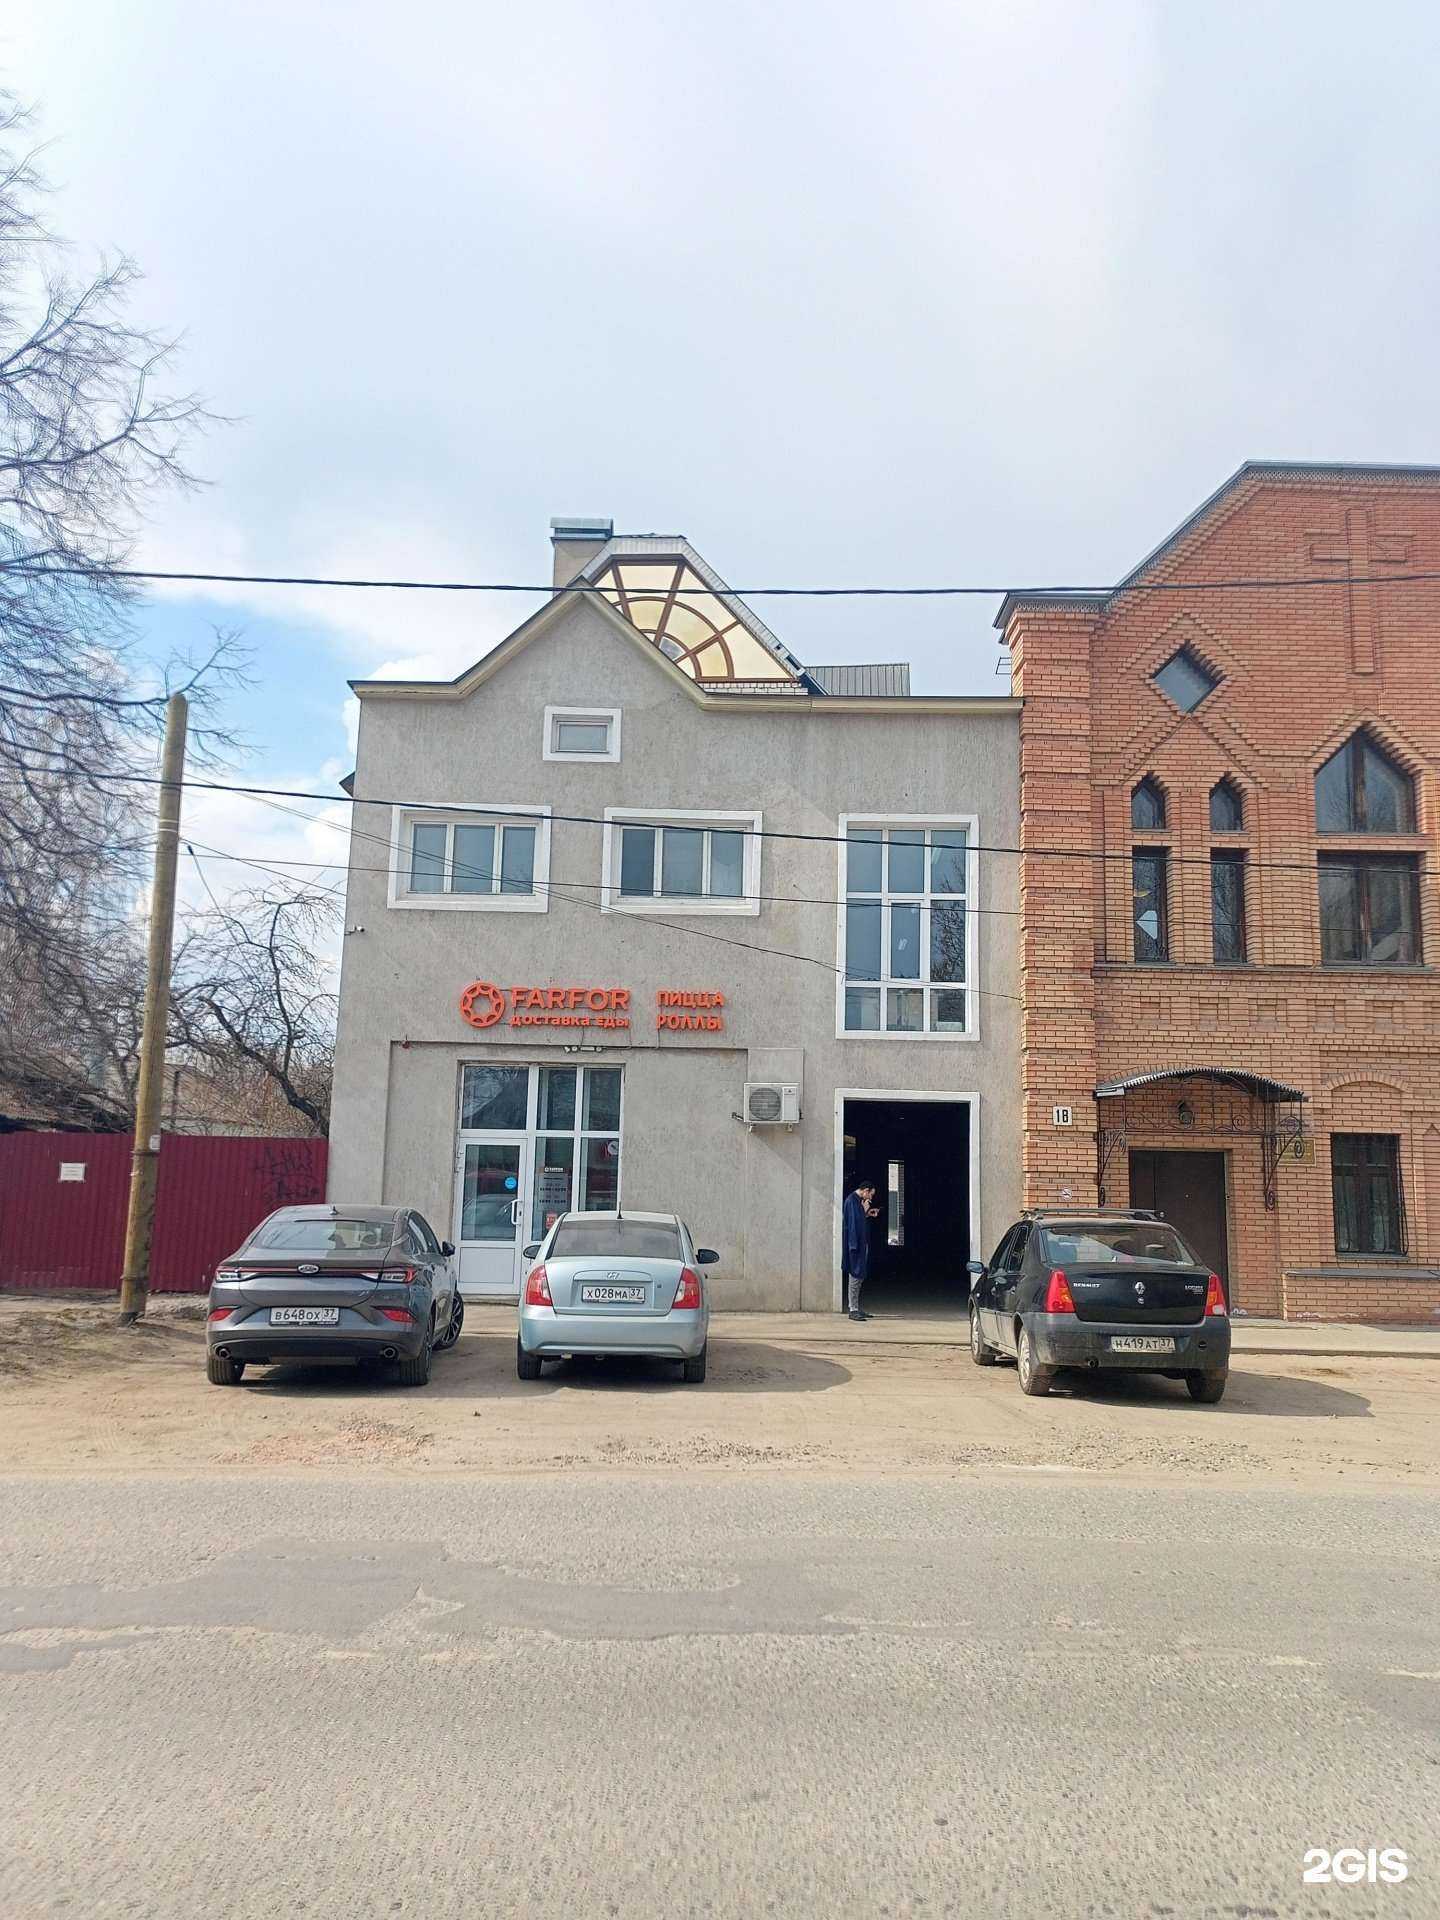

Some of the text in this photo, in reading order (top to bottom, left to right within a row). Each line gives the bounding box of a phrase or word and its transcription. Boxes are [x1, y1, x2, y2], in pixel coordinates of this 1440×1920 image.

[511, 986, 630, 1010] FARFOR
[656, 991, 724, 1009] ПИЦЦА
[510, 1014, 630, 1029] доставка еды
[656, 1014, 723, 1031] РОЛЛЫ
